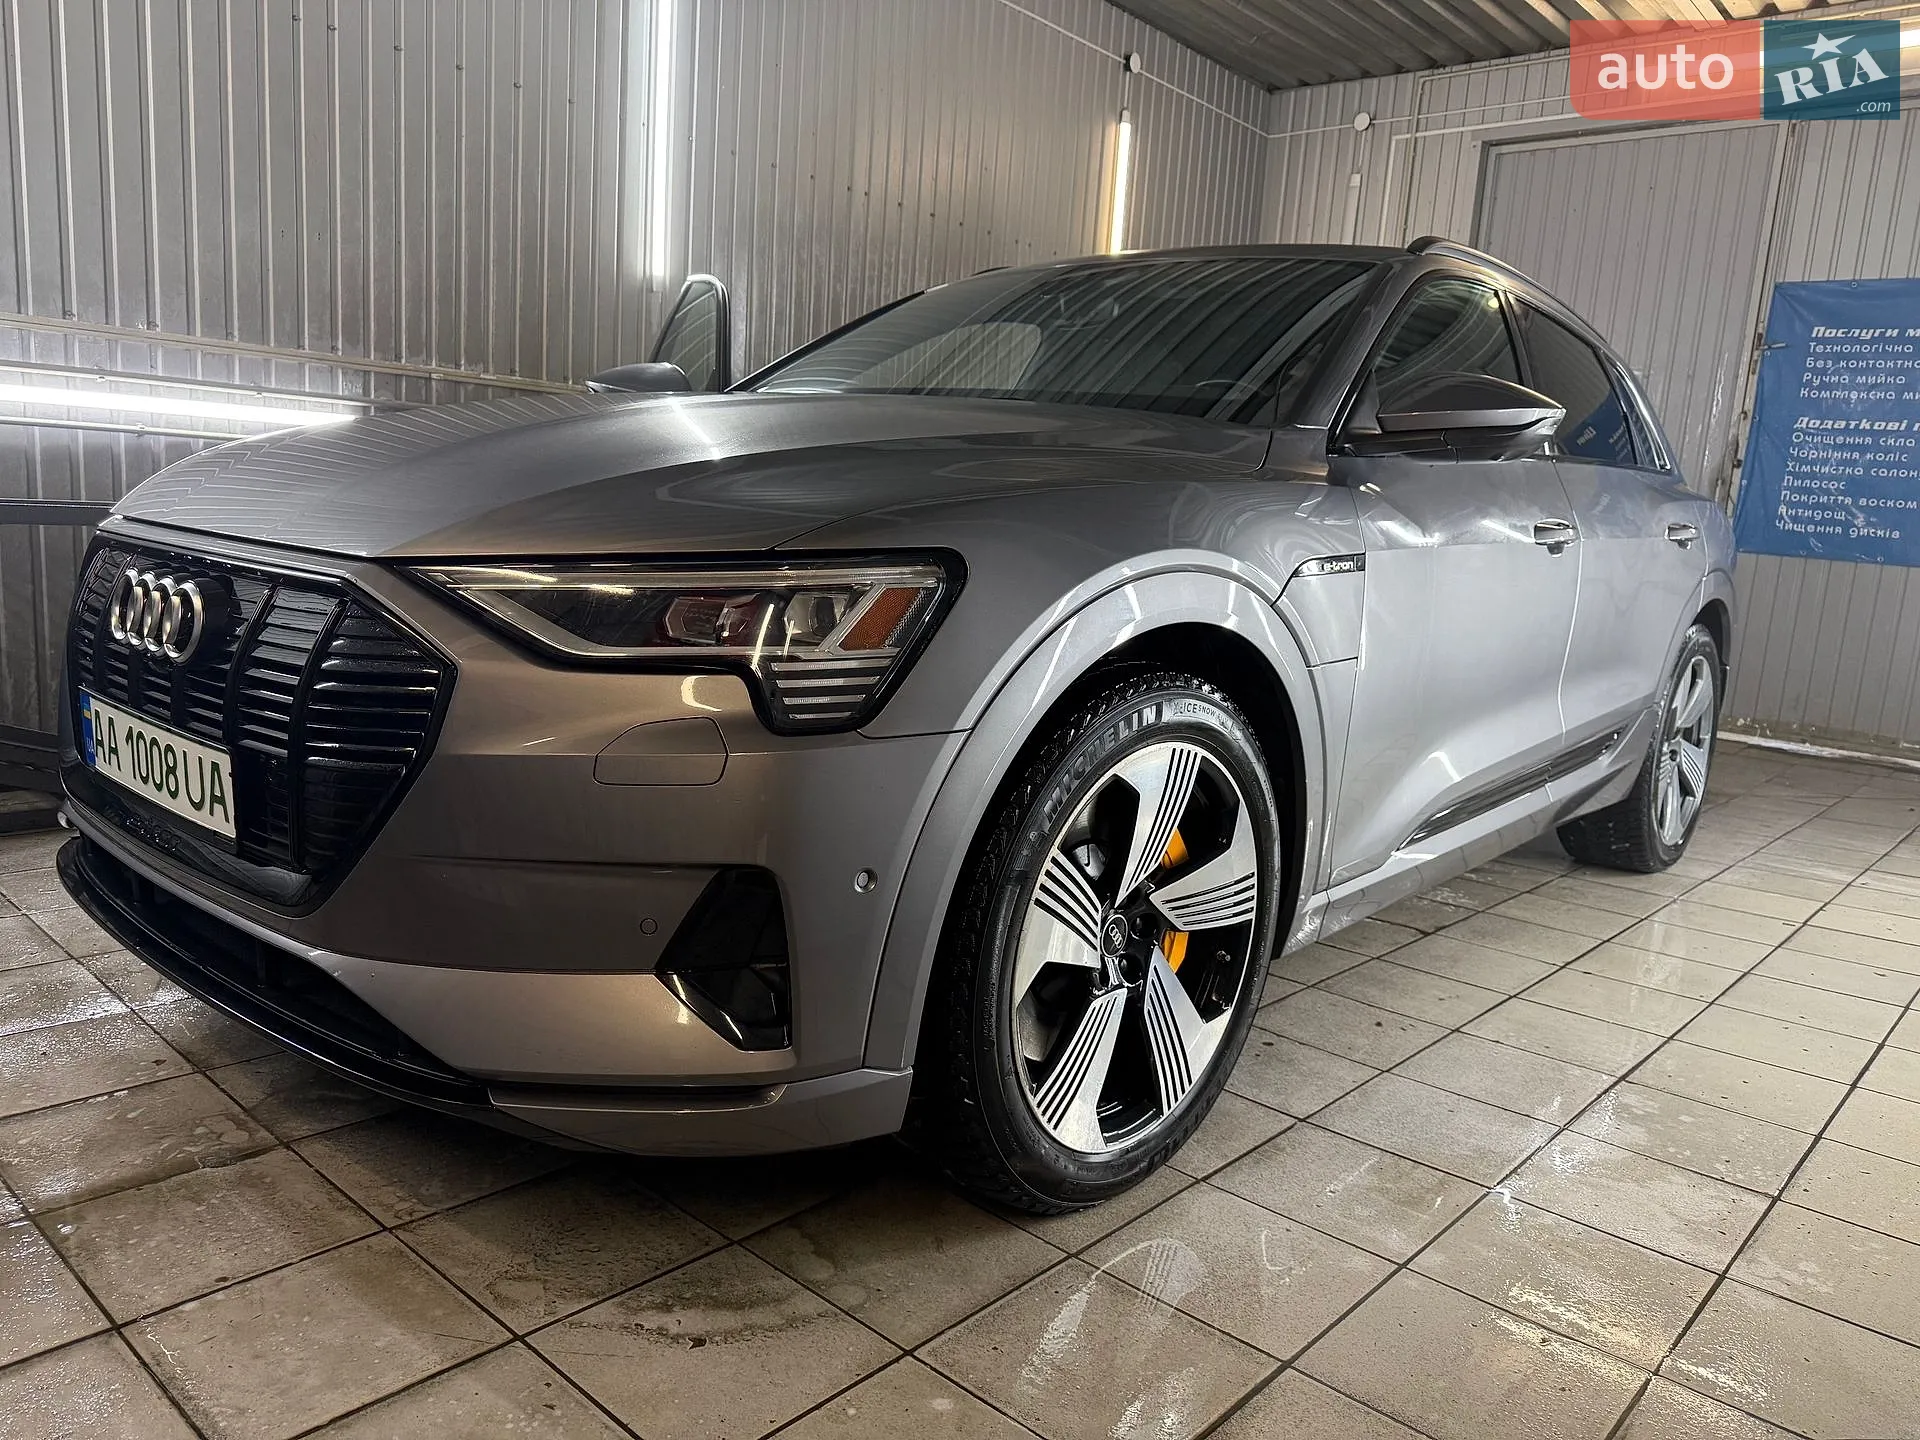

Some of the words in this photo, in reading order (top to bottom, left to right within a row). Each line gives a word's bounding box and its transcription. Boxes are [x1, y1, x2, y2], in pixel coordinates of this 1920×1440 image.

[1811, 326, 1899, 340] Послуги
[1809, 342, 1914, 353] Технологічна
[1806, 357, 1833, 368] Без
[1803, 372, 1849, 386] Ручна
[1856, 373, 1906, 384] мийка
[1800, 387, 1896, 400] Комплексна
[1793, 416, 1909, 431] Додаткові
[1792, 431, 1872, 445] Очищення
[1879, 436, 1915, 447] скла
[1789, 446, 1859, 460] Чорніння
[1866, 451, 1908, 462] коліс
[1786, 461, 1864, 475] Хімчистка
[1783, 475, 1846, 489] Пилосос
[1780, 490, 1852, 505] Покриття
[1859, 498, 1917, 509] воском
[1778, 504, 1846, 520] Антидощ
[1775, 519, 1842, 534] Чищення
[1849, 527, 1900, 539] дисків
[1323, 561, 1354, 572] e-tron
[94, 708, 121, 772] AA
[125, 725, 180, 800] 1008
[183, 749, 230, 824] UA
[1043, 704, 1157, 825] MICHELIN
